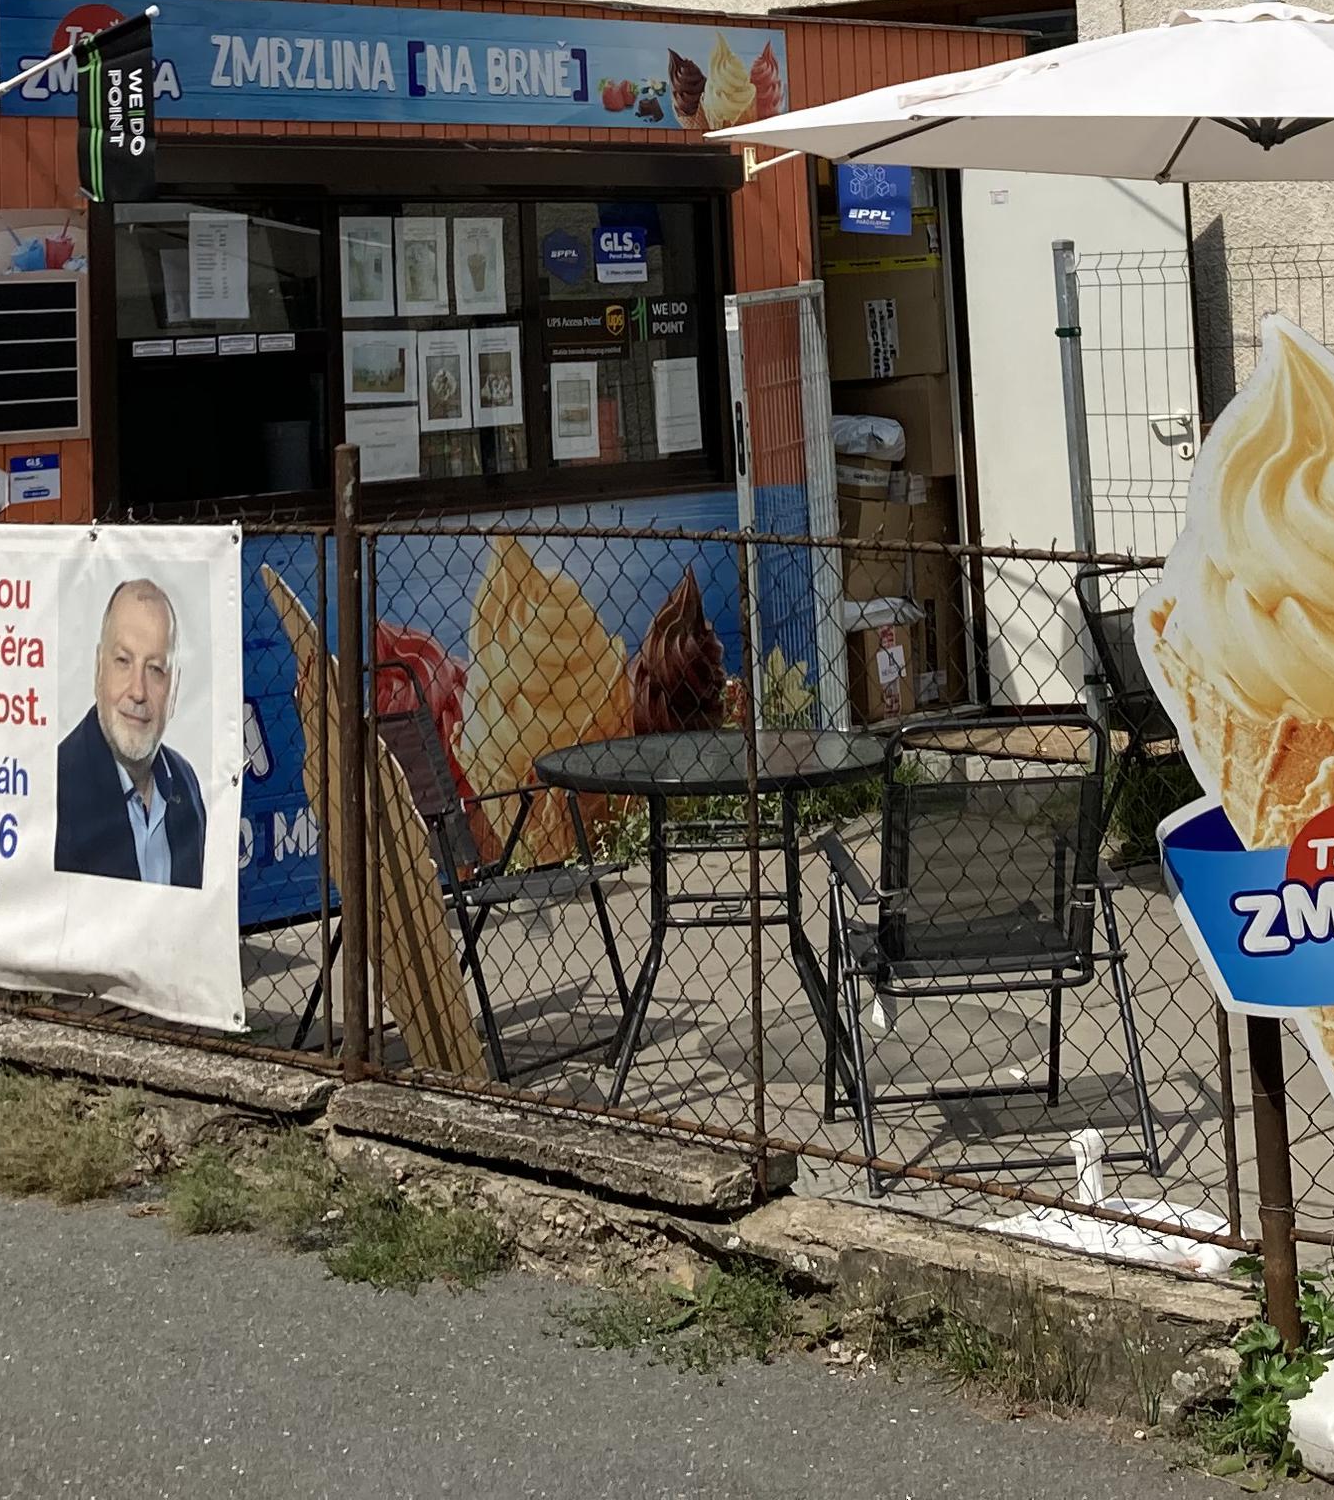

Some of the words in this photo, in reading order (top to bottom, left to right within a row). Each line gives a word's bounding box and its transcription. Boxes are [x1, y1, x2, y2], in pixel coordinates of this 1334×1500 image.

[210, 34, 396, 92] ZMRZLINA
[107, 69, 126, 148] POINT
[858, 209, 891, 221] PPL
[600, 232, 634, 253] GLS
[556, 249, 579, 258] PPL
[546, 317, 561, 328] UPS
[562, 317, 583, 328] Access
[583, 316, 603, 327] Point
[652, 321, 685, 334] POINT
